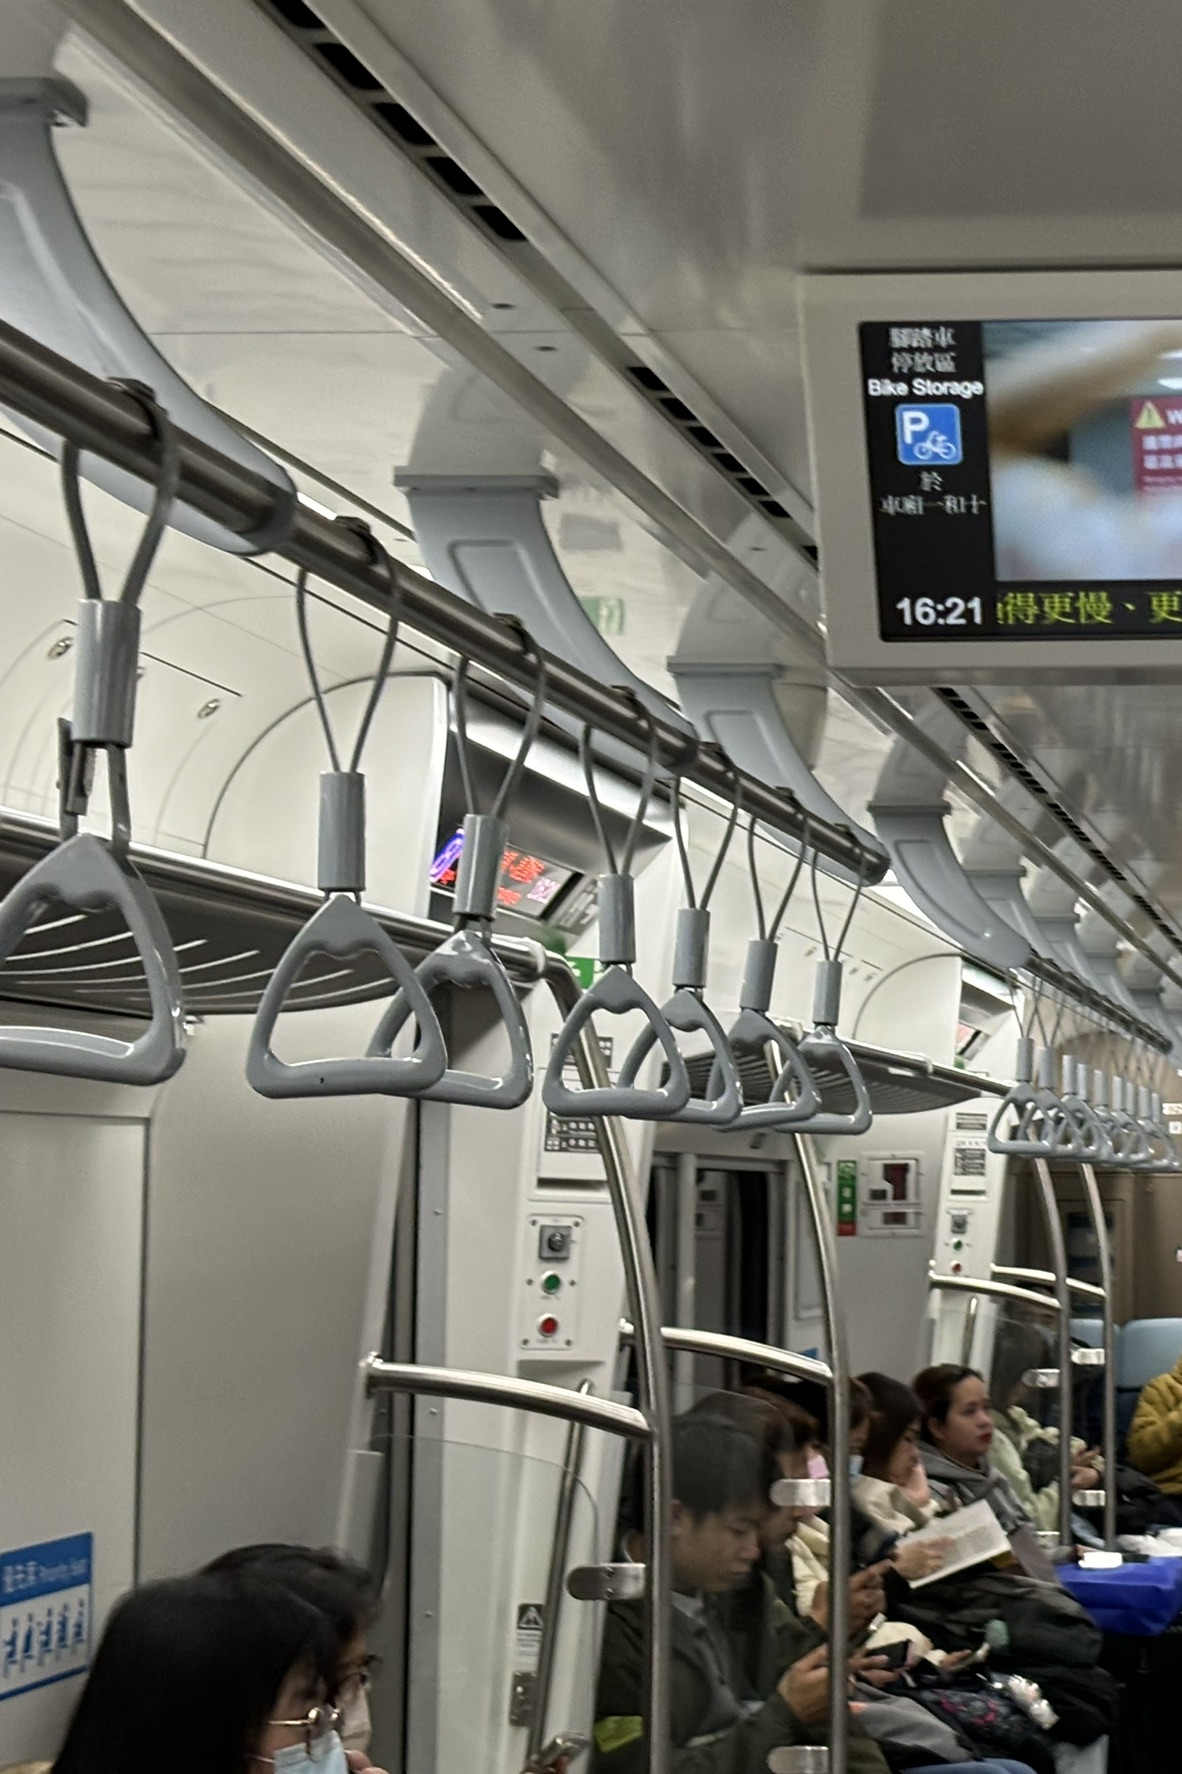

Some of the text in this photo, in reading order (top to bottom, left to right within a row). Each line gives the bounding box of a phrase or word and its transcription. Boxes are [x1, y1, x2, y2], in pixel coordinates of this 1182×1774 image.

[867, 378, 985, 399] Bike Storage
[902, 410, 930, 445] P
[896, 596, 983, 625] 16:21
